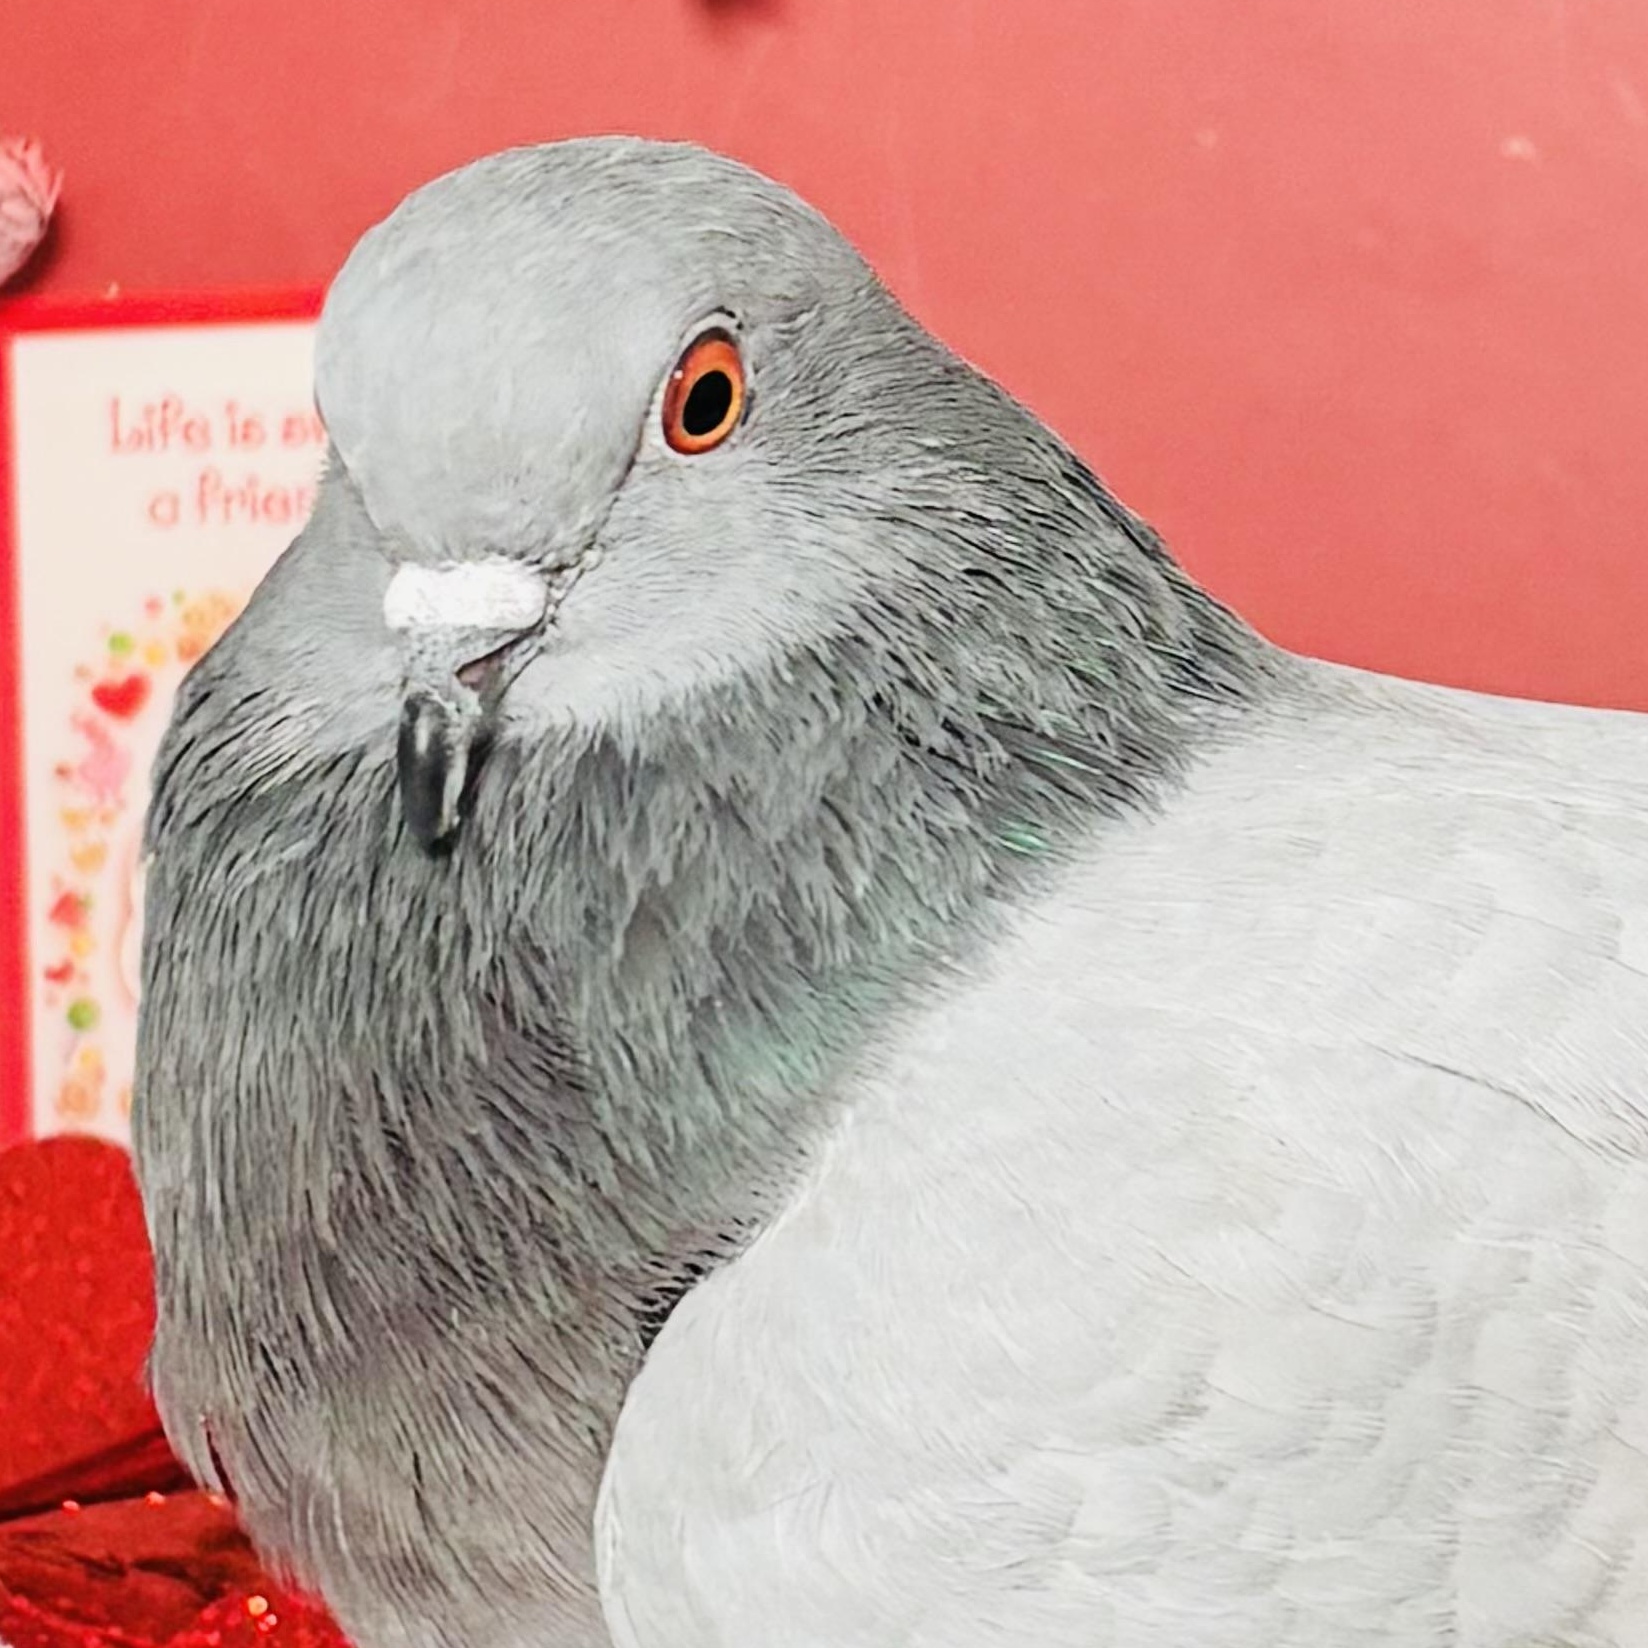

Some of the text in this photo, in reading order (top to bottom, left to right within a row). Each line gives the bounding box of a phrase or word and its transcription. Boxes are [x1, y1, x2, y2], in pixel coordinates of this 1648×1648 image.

[110, 394, 213, 451] Life
[226, 400, 266, 448] is
[148, 490, 181, 527] a
